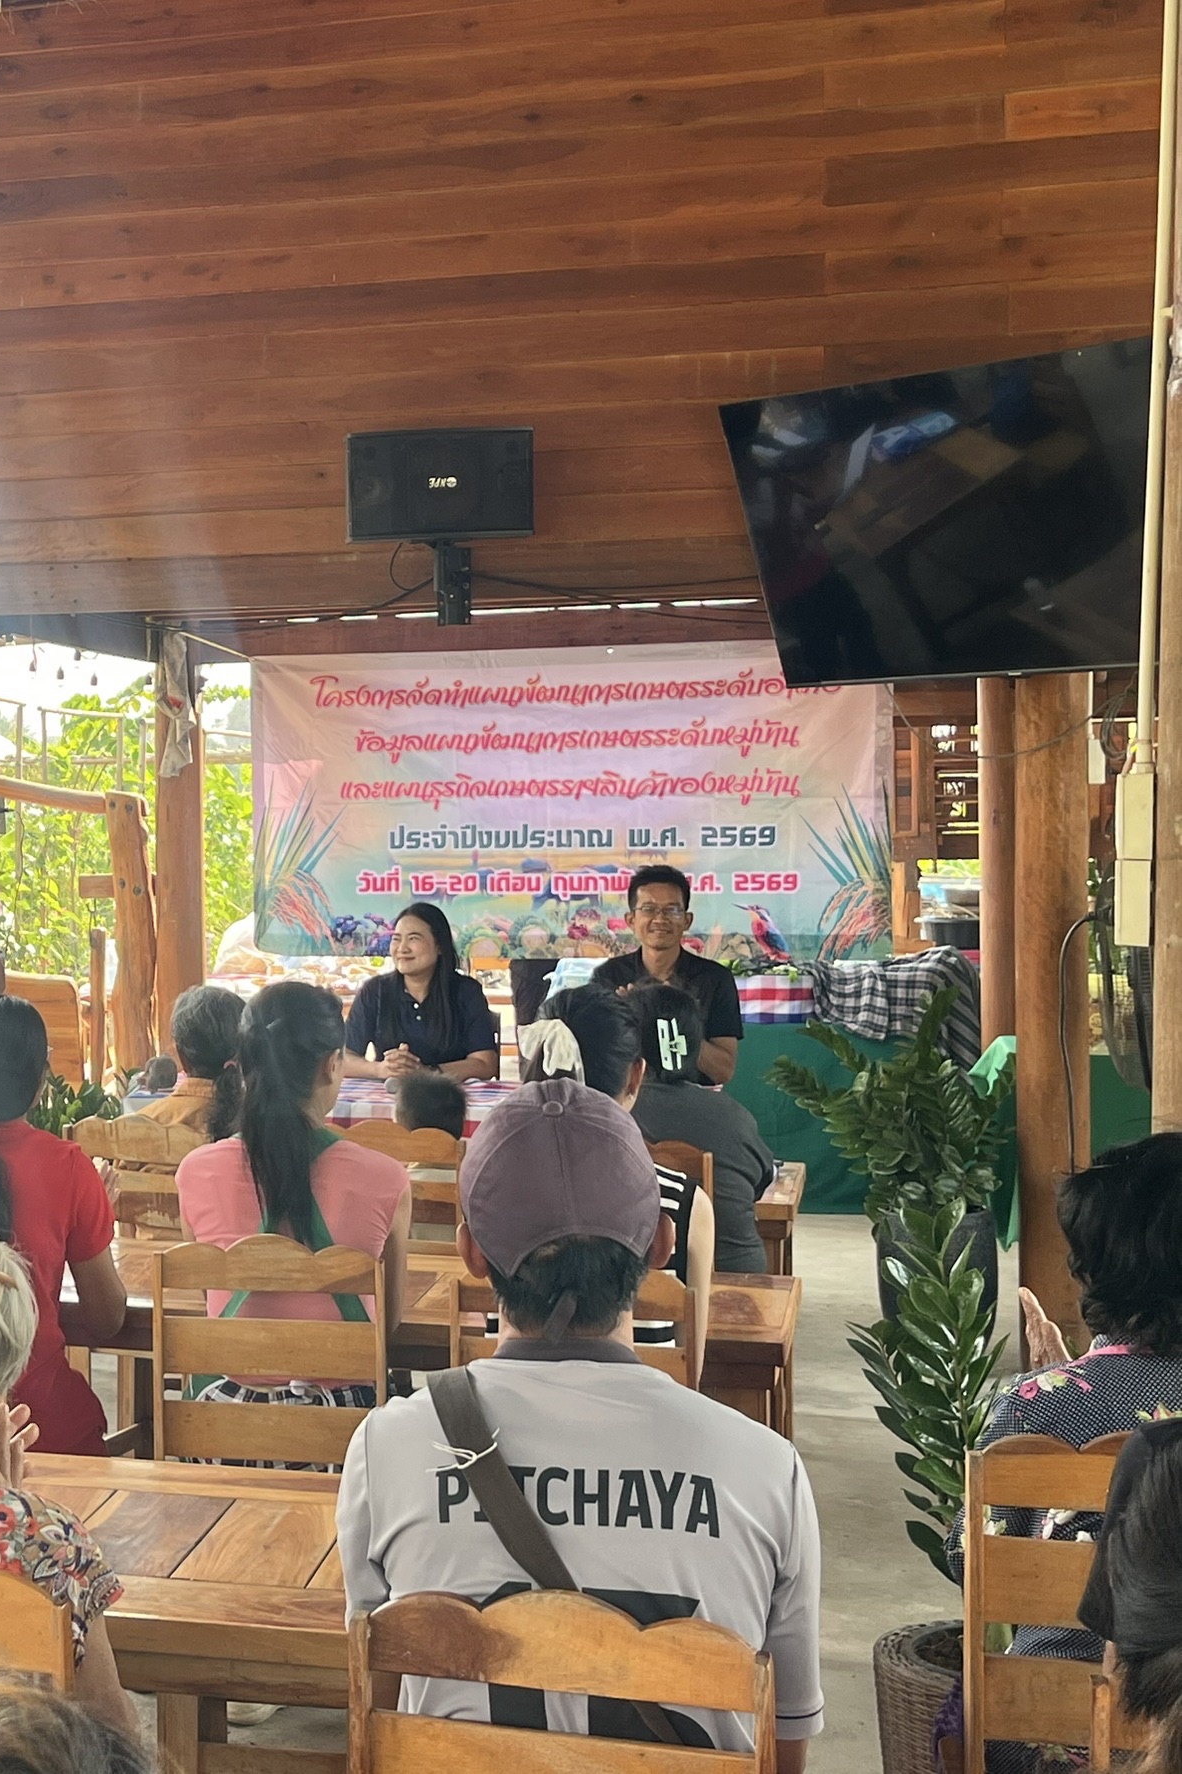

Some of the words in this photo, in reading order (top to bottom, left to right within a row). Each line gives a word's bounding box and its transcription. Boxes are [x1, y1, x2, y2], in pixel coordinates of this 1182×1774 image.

[355, 715, 799, 764] ข้อมูลแผนพัฒนาการเกษตรระดับหมู่บ้าน
[389, 824, 613, 849] ประจำปีงบประมาณ
[628, 826, 685, 848] พ.ศ.
[700, 826, 776, 848] 2569
[358, 868, 400, 893] วันที่
[411, 874, 477, 893] 16-20
[489, 871, 541, 893] เดือน
[734, 874, 798, 892] 2569
